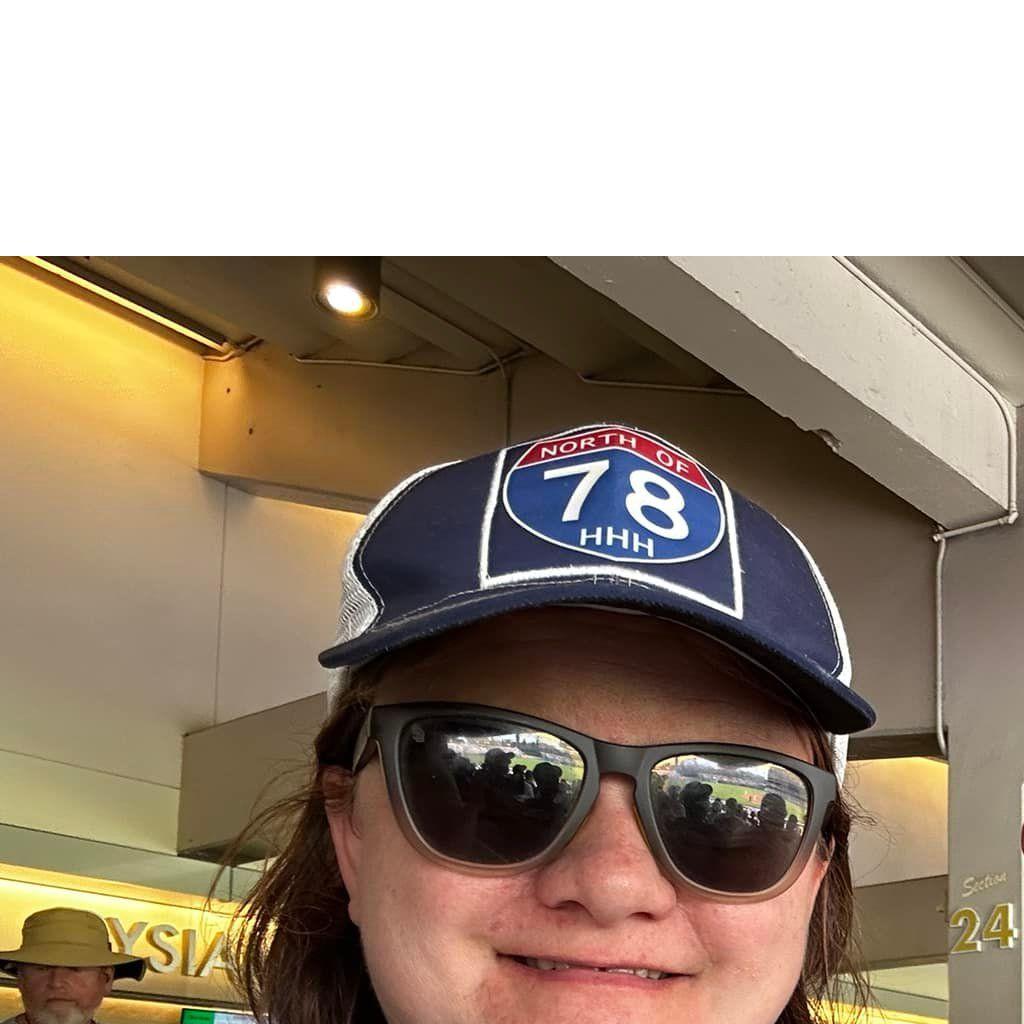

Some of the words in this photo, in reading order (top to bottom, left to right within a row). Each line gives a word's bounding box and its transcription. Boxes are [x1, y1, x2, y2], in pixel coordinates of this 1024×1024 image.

[540, 432, 637, 459] NORTH
[655, 449, 690, 475] OF
[543, 459, 689, 540] 78
[579, 526, 655, 558] HHH
[961, 871, 1009, 898] Section
[949, 902, 1019, 955] 24
